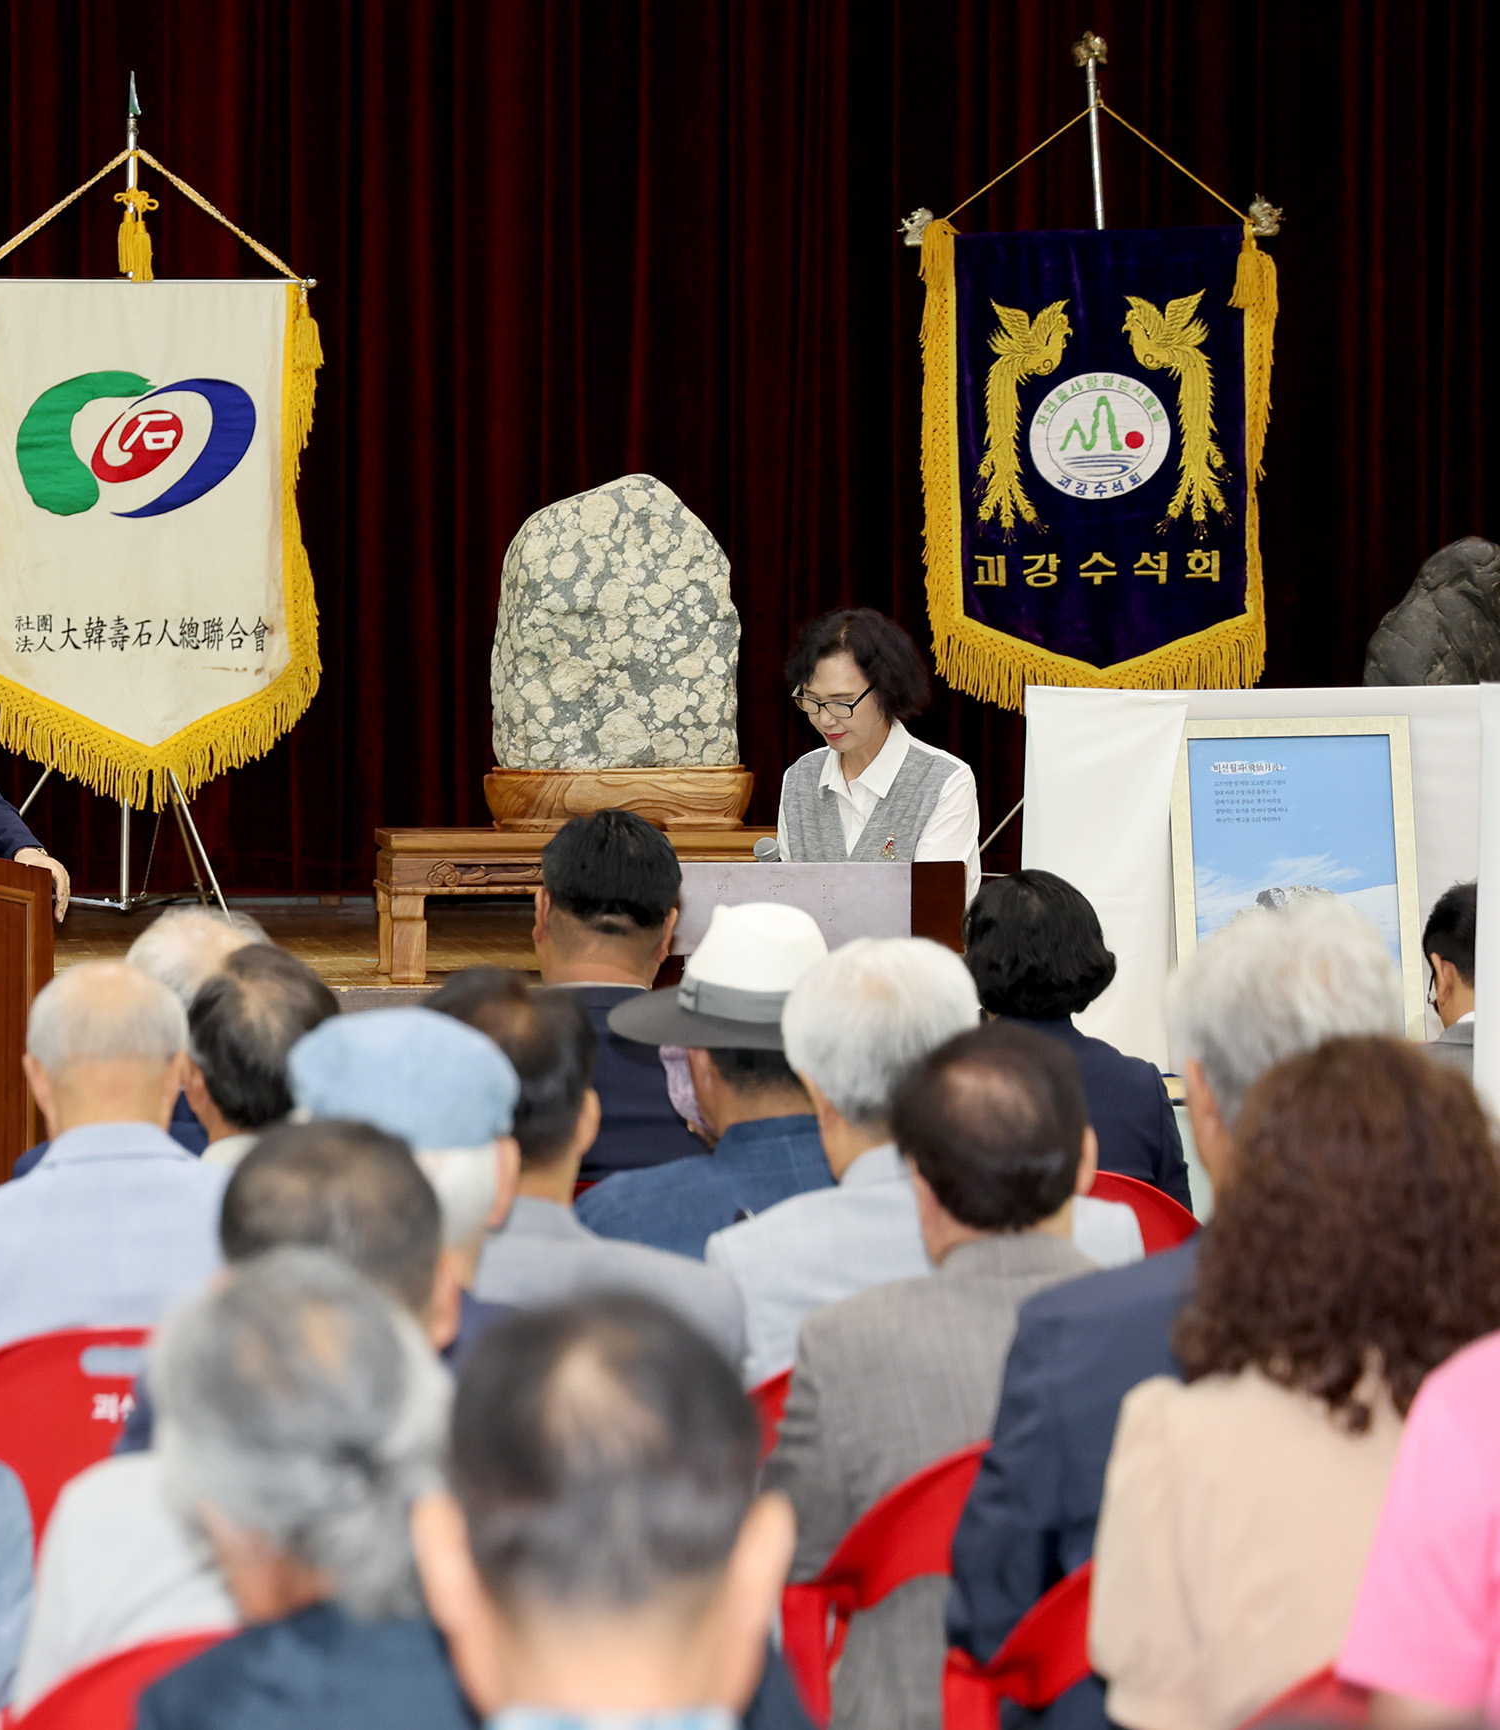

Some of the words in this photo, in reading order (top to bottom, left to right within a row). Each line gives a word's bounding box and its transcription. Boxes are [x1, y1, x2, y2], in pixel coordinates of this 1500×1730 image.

[122, 413, 177, 451] 石
[973, 549, 1221, 588] 괴강수석회
[14, 636, 56, 654] 法人
